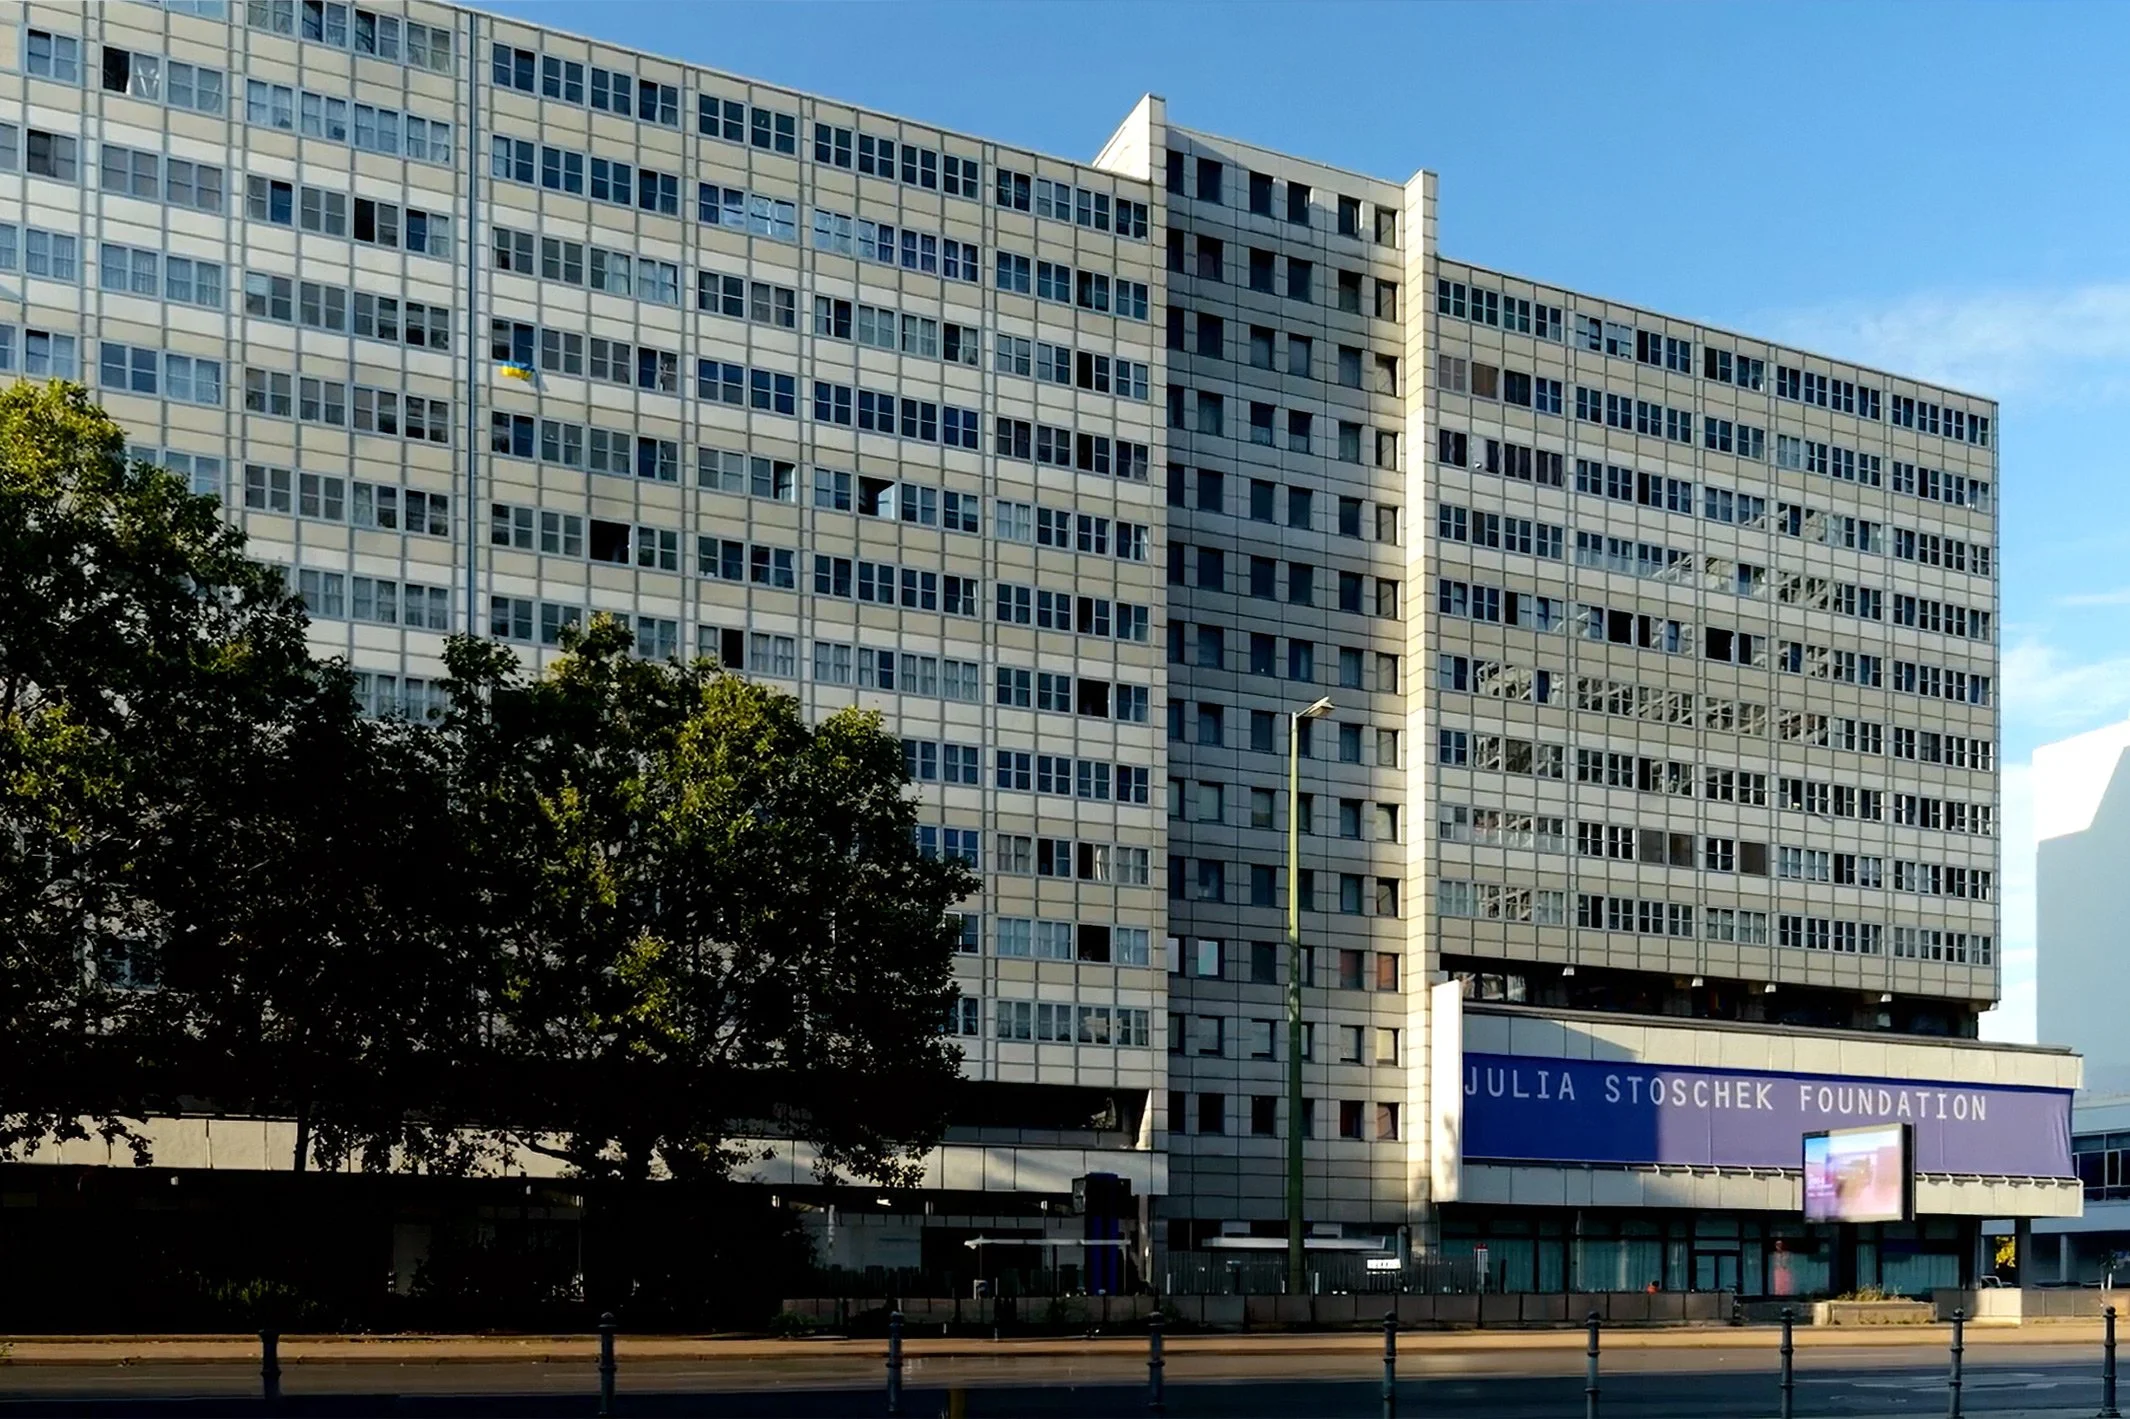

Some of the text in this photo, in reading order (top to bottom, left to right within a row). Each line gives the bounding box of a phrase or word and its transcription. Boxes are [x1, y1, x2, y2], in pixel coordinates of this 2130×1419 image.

[1464, 1066, 1986, 1121] JULIA STOSCHEK FOUNDATION
